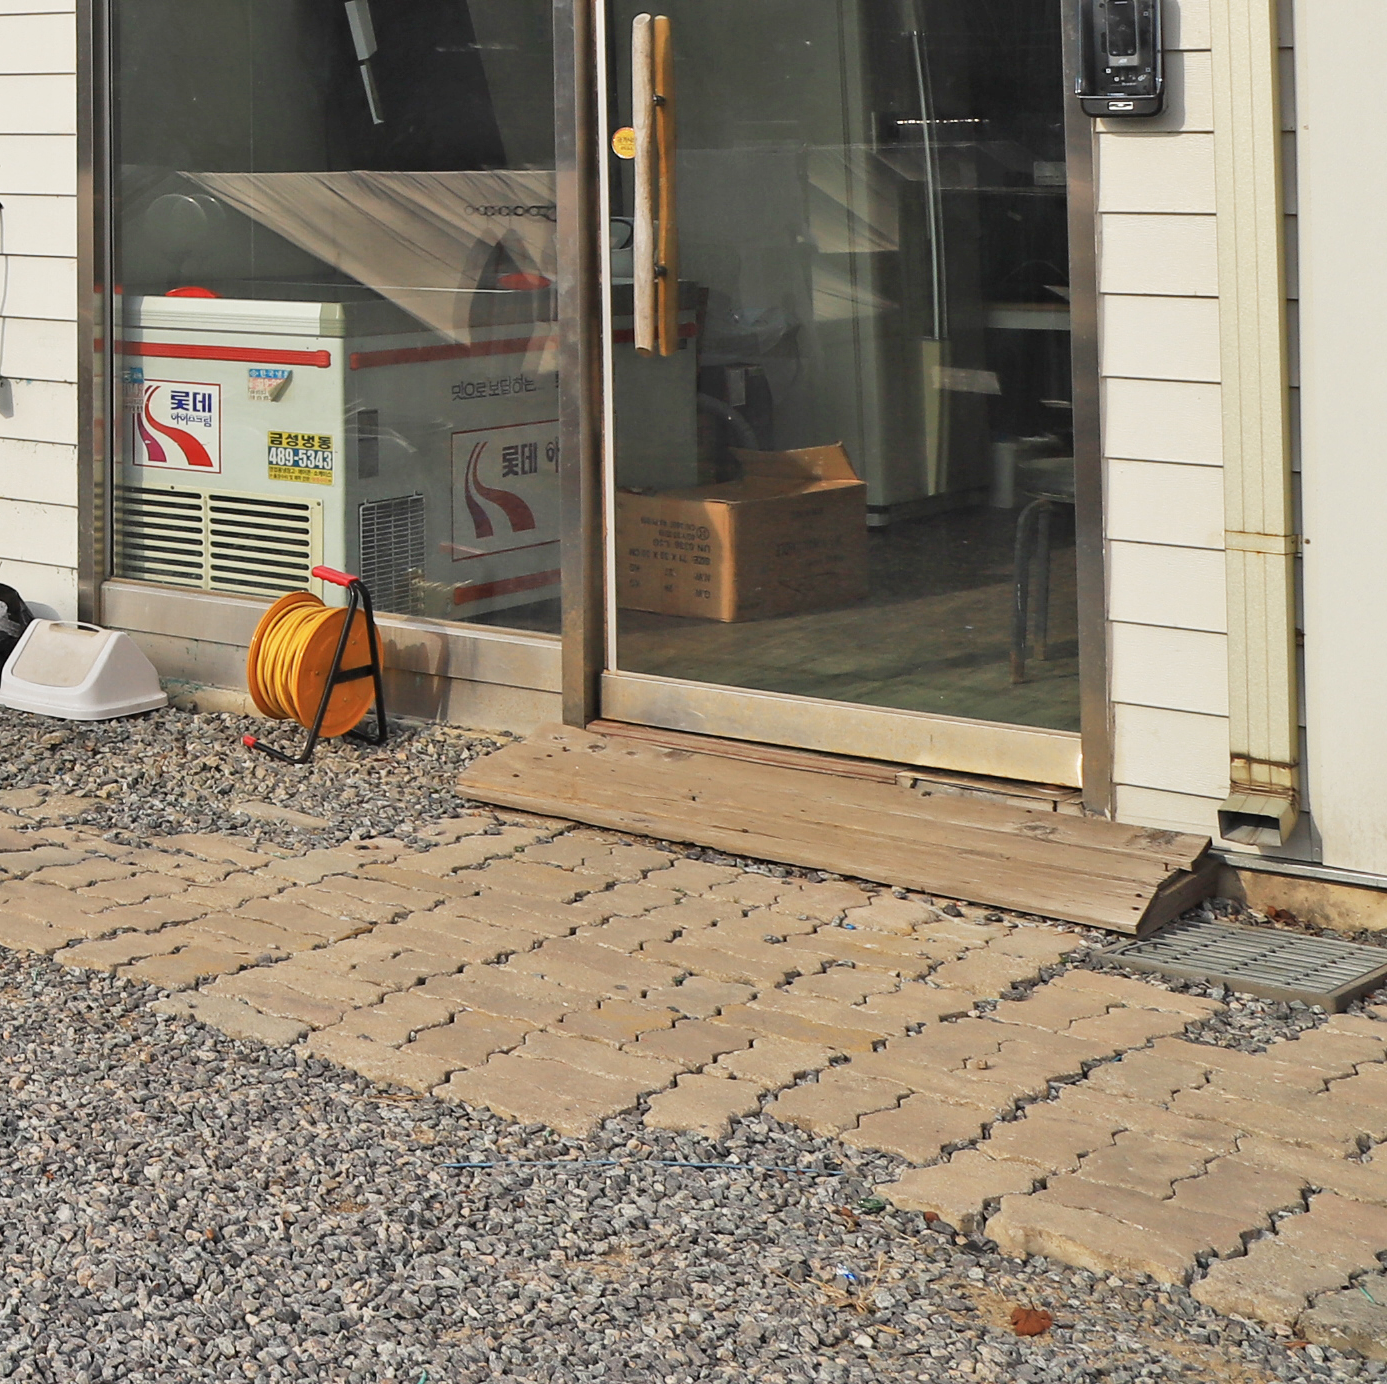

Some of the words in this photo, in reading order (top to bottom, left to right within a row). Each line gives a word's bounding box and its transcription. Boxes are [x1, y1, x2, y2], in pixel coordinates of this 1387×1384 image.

[170, 389, 213, 414] 롯데
[170, 412, 213, 428] 아이스크림
[270, 432, 332, 450] 금성냉동
[269, 446, 333, 470] 489-5343
[502, 441, 538, 478] 롯데
